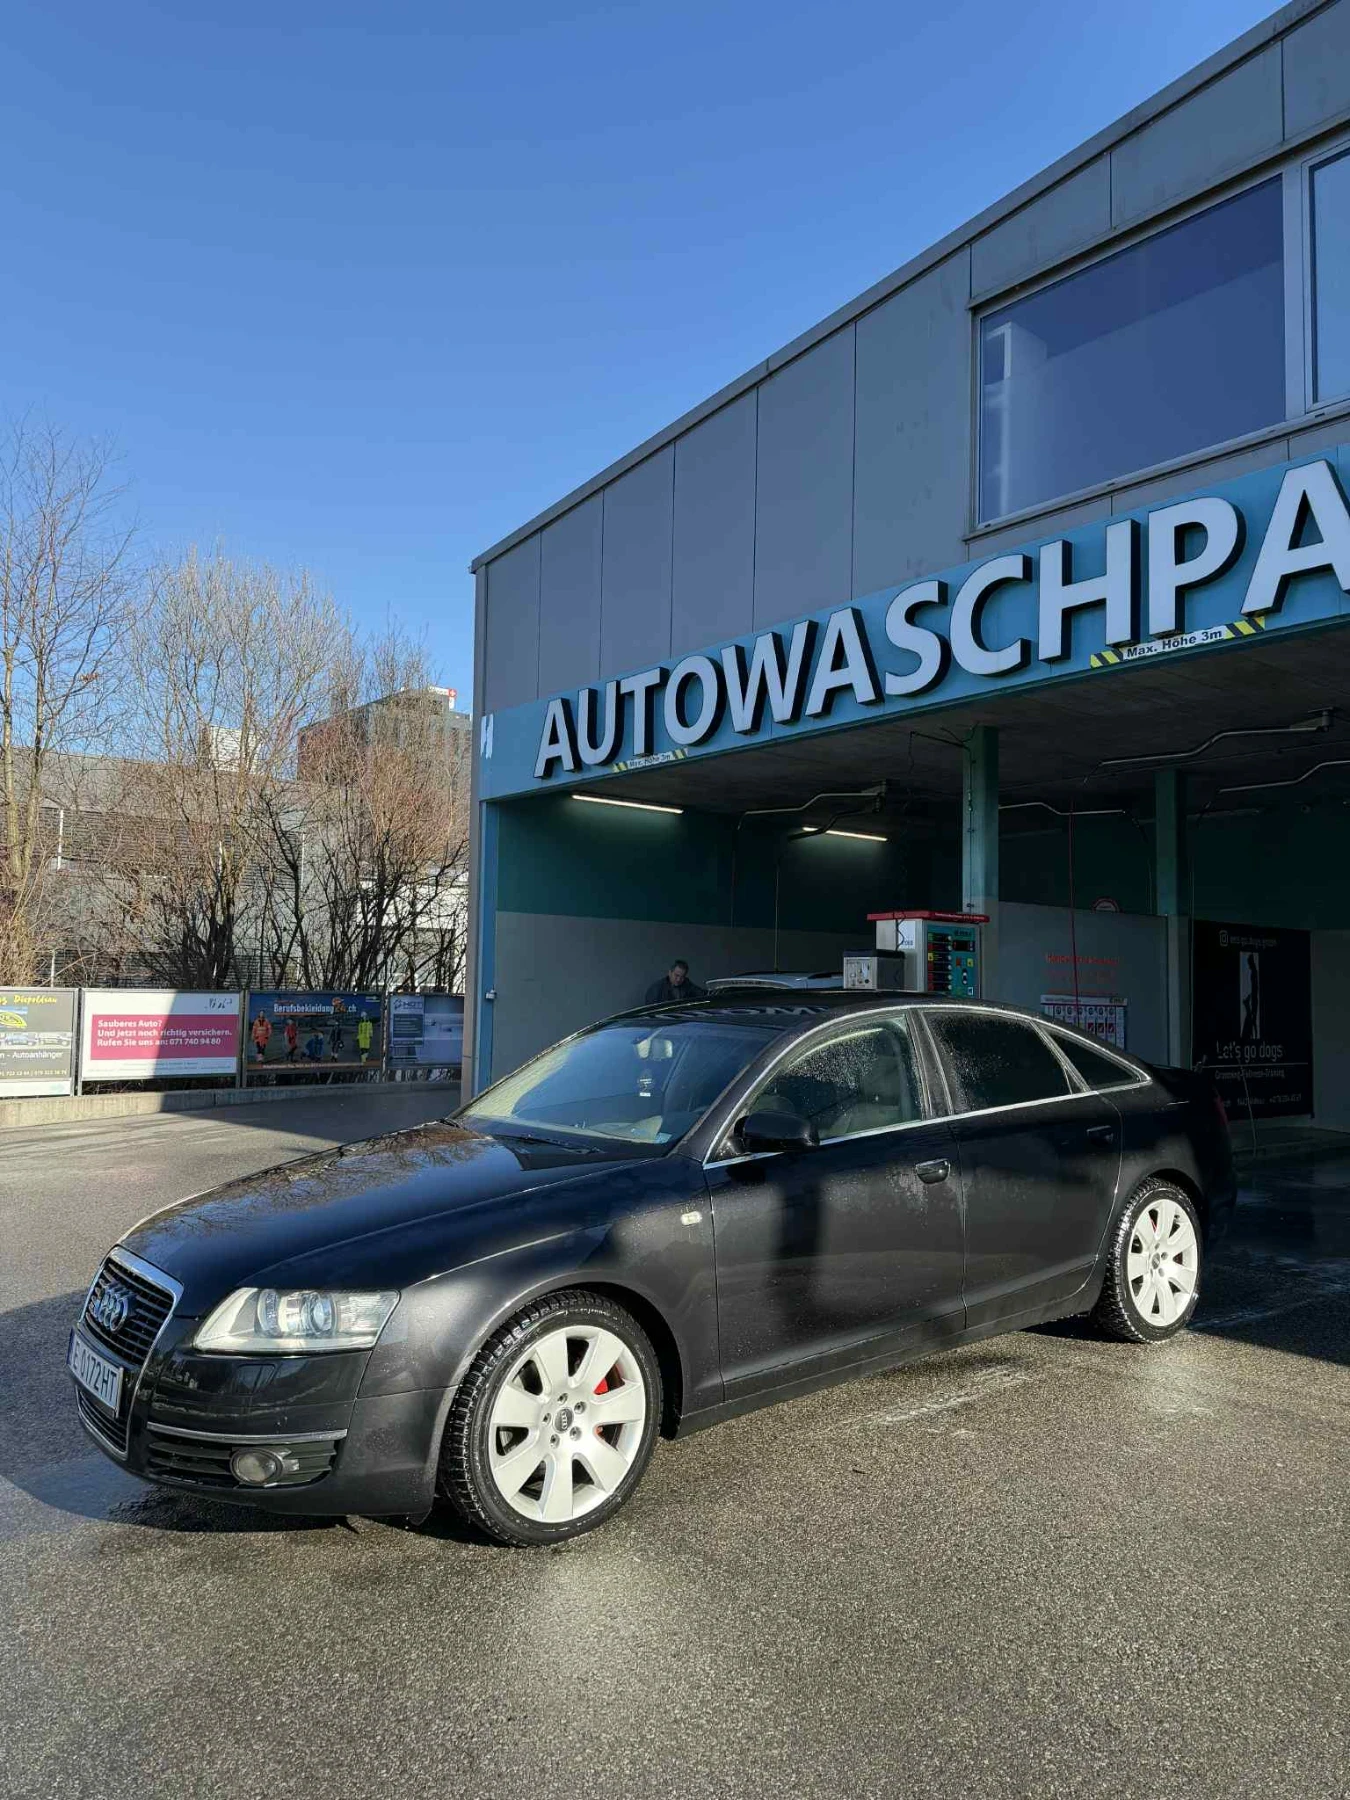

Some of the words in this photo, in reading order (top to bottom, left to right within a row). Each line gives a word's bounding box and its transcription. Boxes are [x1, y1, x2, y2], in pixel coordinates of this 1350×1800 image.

[1127, 645, 1158, 659] Max.
[1162, 635, 1197, 651] Höhe
[1201, 629, 1222, 643] 3m
[98, 1020, 137, 1028] Sauberes
[138, 1019, 163, 1028] Auto?
[97, 1029, 115, 1037] Und
[116, 1029, 136, 1039] jetzt
[138, 1029, 158, 1037] noch
[160, 1028, 187, 1038] richtig
[188, 1028, 232, 1036] versichern.
[97, 1039, 122, 1047] Rufen
[124, 1038, 137, 1046] Sie
[138, 1039, 153, 1047] uns
[184, 1038, 199, 1046] 740
[1216, 1039, 1241, 1060] Let's
[1243, 1045, 1257, 1064] go
[1259, 1040, 1284, 1063] dogs
